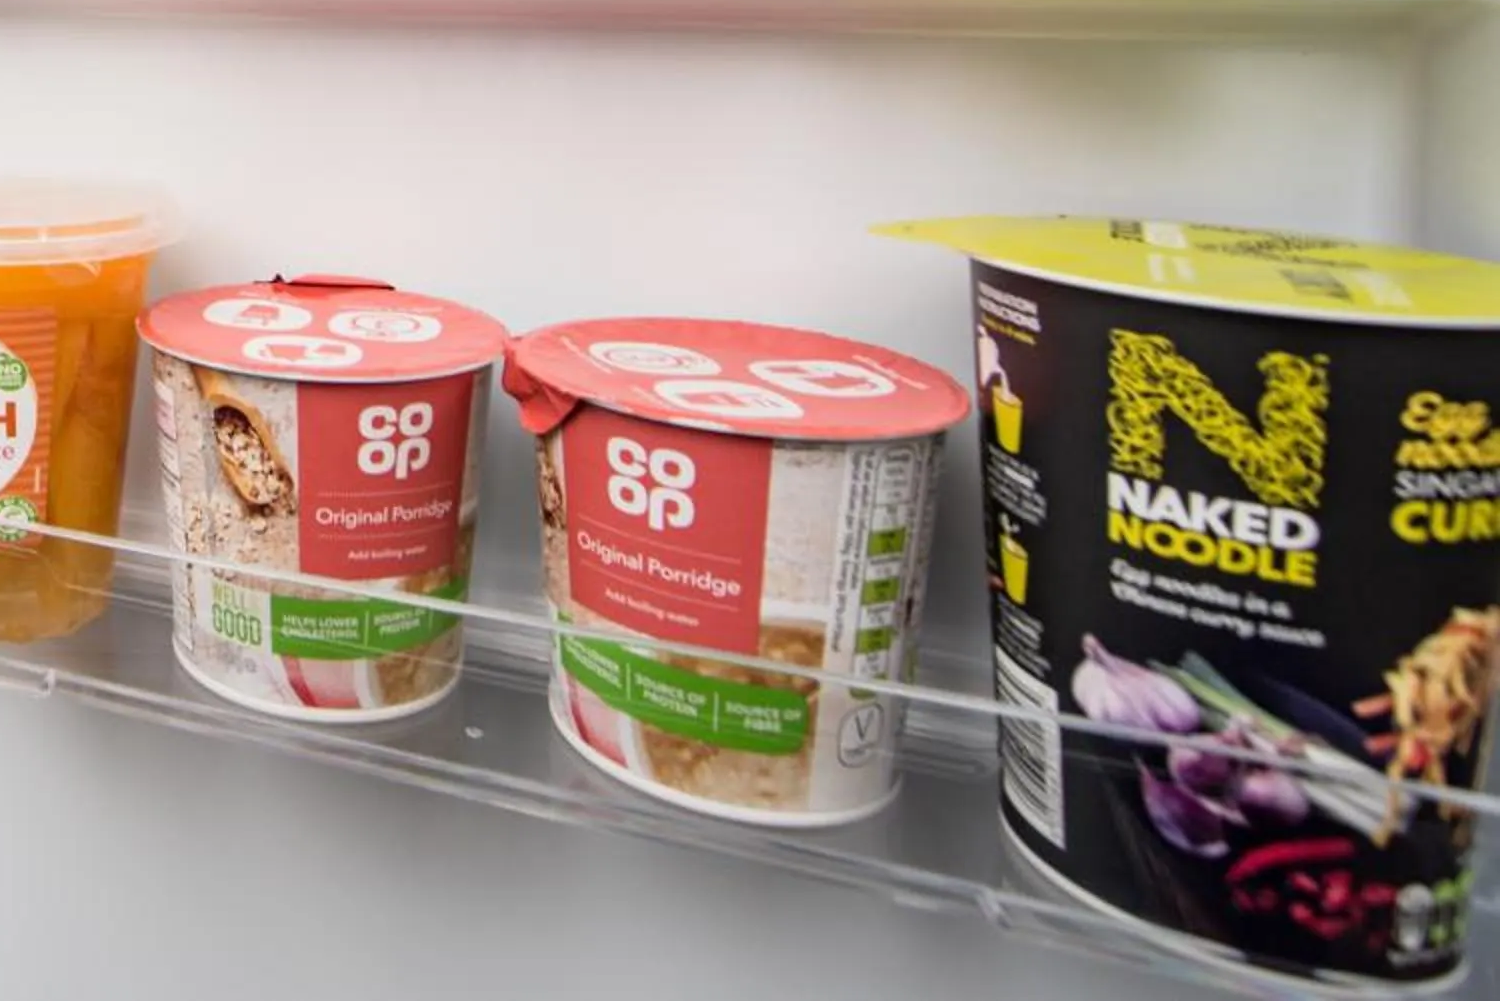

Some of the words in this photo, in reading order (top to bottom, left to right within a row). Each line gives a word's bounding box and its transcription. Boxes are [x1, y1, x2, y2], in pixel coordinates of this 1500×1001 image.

[315, 505, 388, 530] Original
[1106, 472, 1320, 552] NAKED
[1390, 500, 1500, 543] CUR
[577, 530, 644, 572] Original
[648, 556, 742, 597] Porridge
[1107, 511, 1318, 589] NOODLE
[318, 616, 359, 628] LOWER
